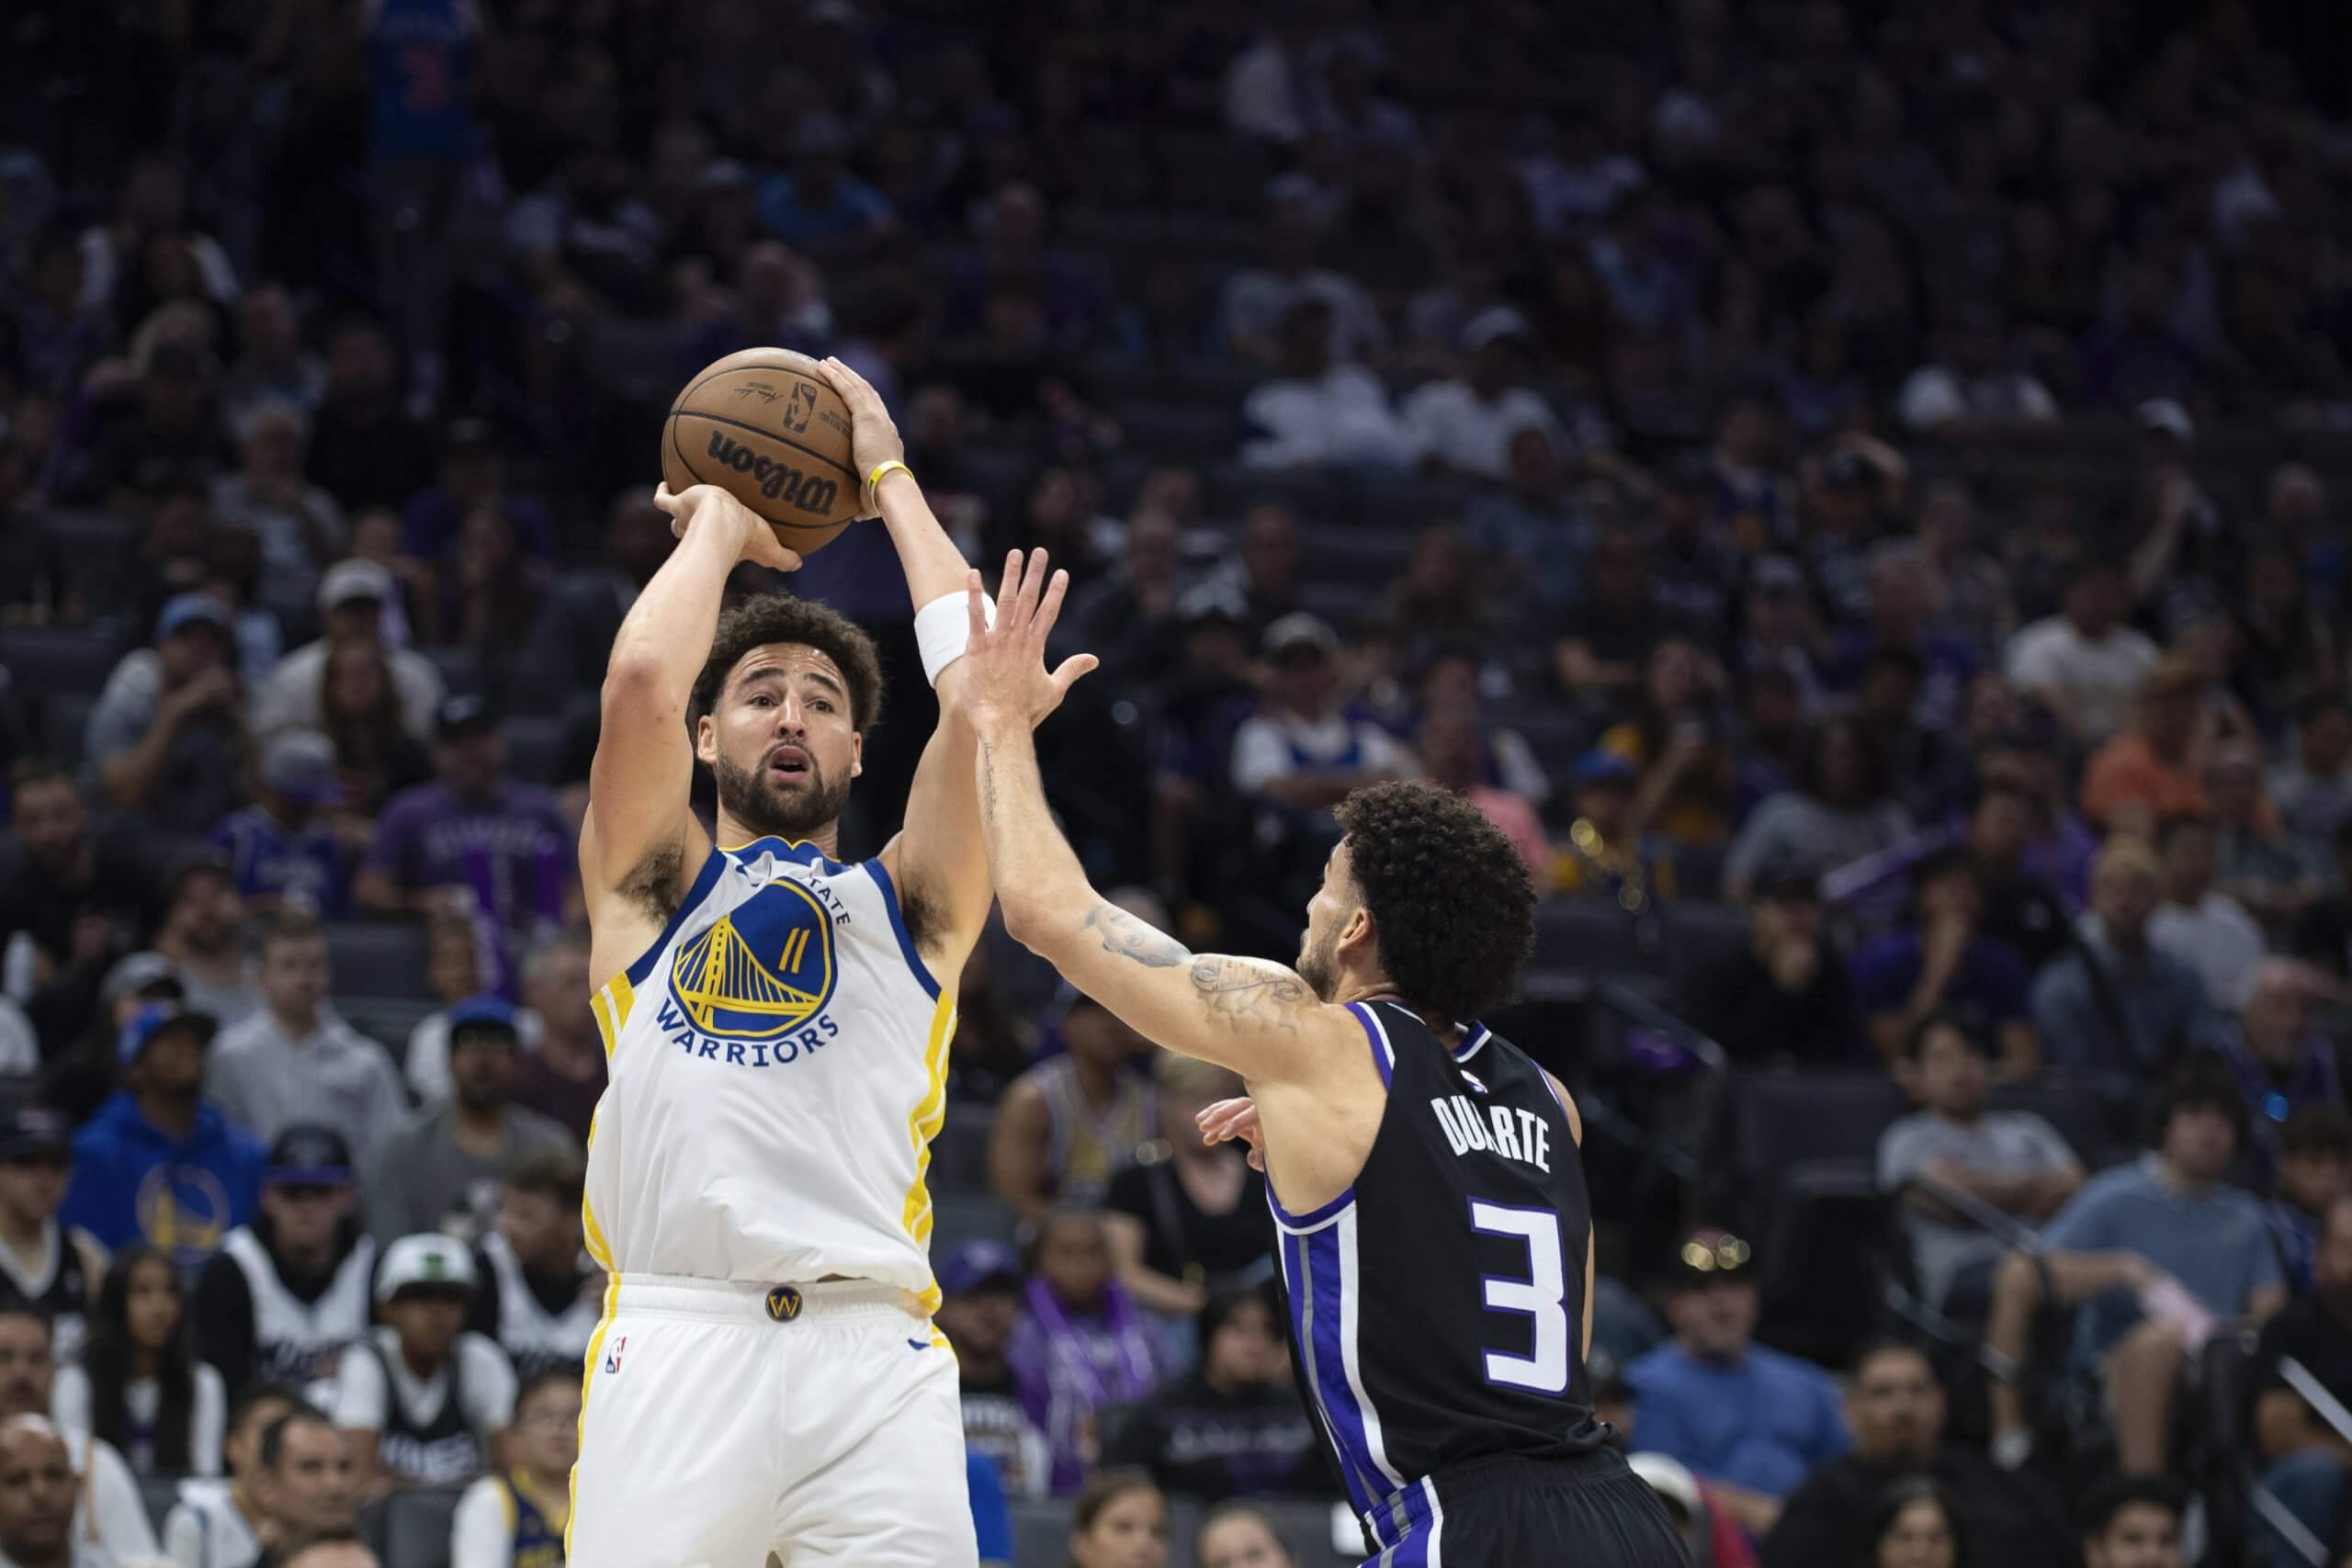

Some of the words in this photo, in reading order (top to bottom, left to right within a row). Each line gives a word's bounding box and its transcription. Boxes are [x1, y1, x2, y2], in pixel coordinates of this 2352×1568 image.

[707, 429, 838, 516] Wilson
[809, 878, 852, 925] TATE
[656, 997, 839, 1067] WARRIORS
[1430, 1094, 1551, 1174] DUARTE
[1467, 1195, 1570, 1397] 3
